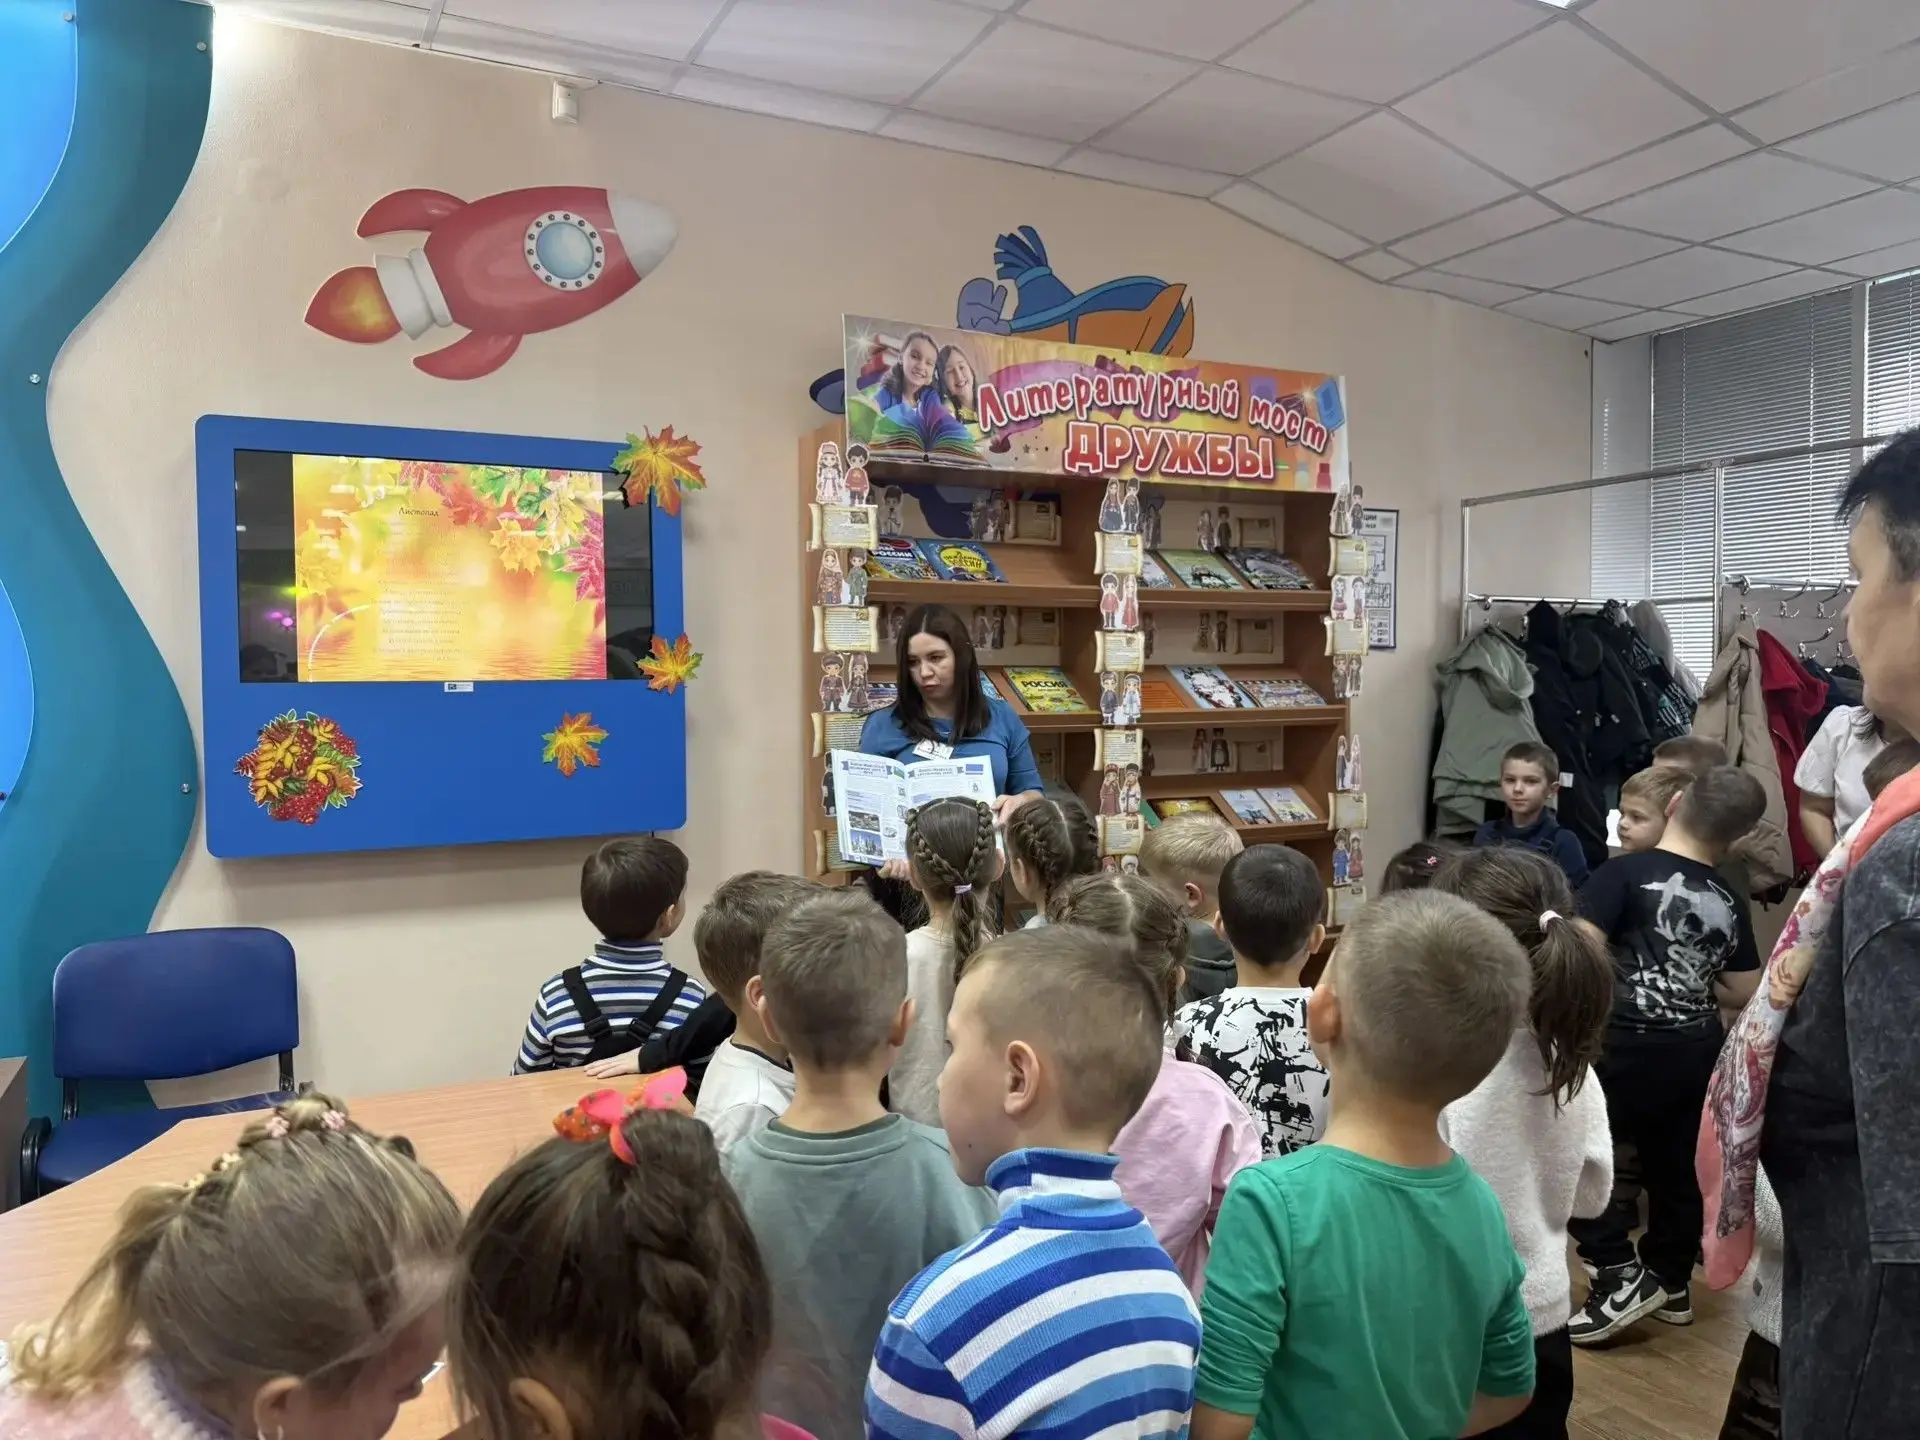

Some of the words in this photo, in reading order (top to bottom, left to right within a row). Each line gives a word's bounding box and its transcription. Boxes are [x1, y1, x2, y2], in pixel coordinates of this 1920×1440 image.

[978, 373, 1239, 432] Литературный
[1248, 395, 1326, 452] мост
[1065, 421, 1274, 478] ДРУЖБЫ
[398, 507, 439, 517] Листопад
[1020, 680, 1068, 688] РОССИЯ
